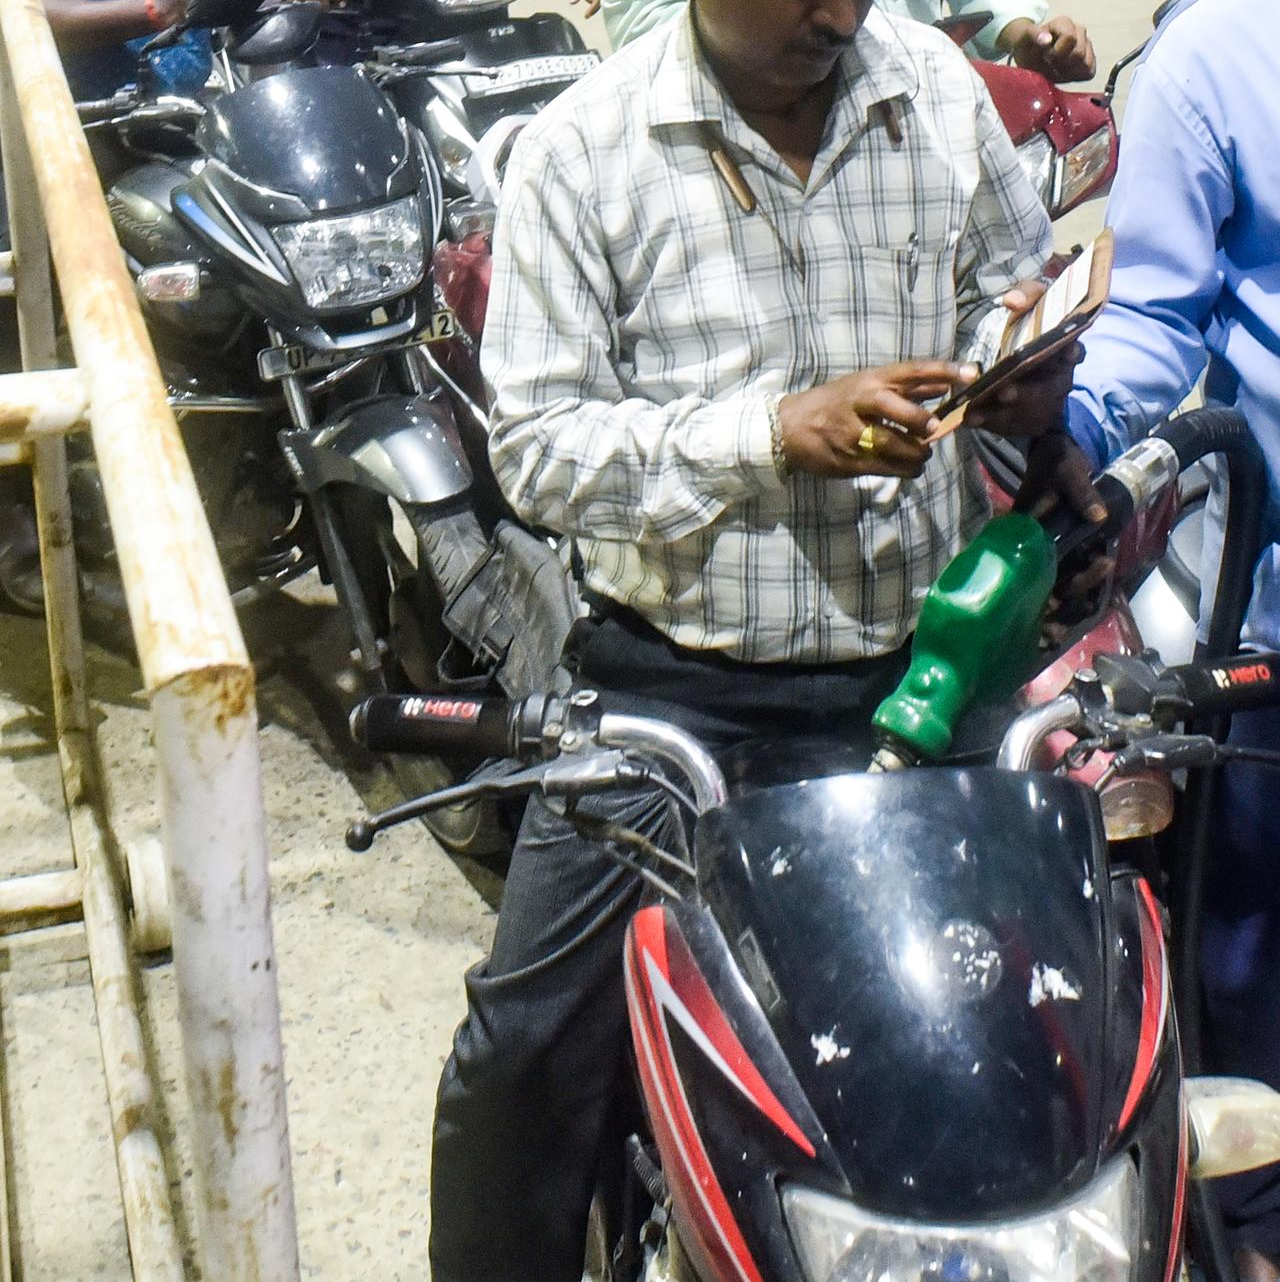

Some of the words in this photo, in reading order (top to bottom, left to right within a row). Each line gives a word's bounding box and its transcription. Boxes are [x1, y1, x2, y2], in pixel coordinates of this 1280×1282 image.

[487, 24, 516, 37] TVS
[1228, 664, 1271, 685] Hero
[423, 699, 477, 718] Hero
